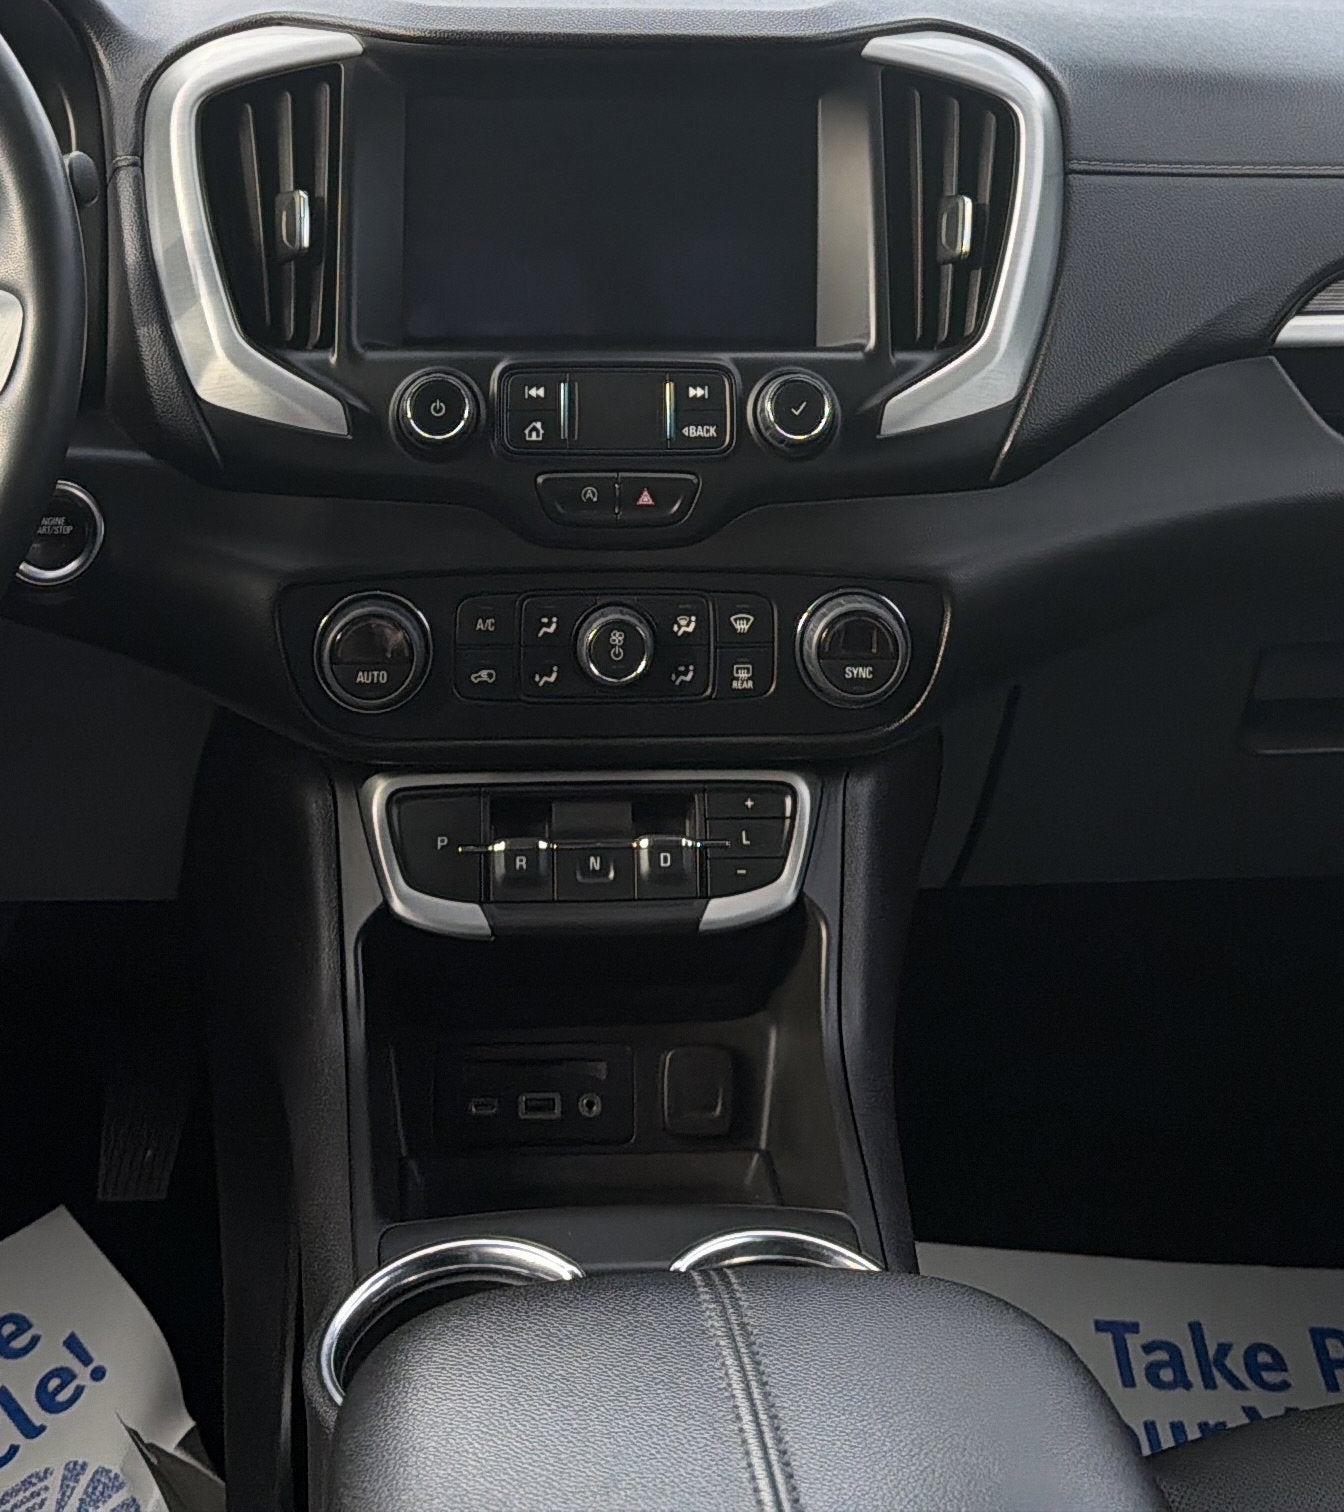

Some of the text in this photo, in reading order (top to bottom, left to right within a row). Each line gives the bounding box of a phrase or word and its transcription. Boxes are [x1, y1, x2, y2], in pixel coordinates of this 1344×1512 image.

[689, 424, 717, 438] BACK
[40, 516, 66, 526] NGINE
[37, 525, 73, 535] ART/STOP
[475, 618, 496, 631] A/C
[355, 671, 388, 684] AUTO
[844, 666, 874, 679] SYNC
[732, 679, 754, 690] REAR
[437, 835, 448, 850] P
[741, 830, 751, 845] L
[515, 855, 527, 869] R
[589, 855, 601, 870] N
[659, 852, 671, 867] D
[1093, 1319, 1293, 1393] Take
